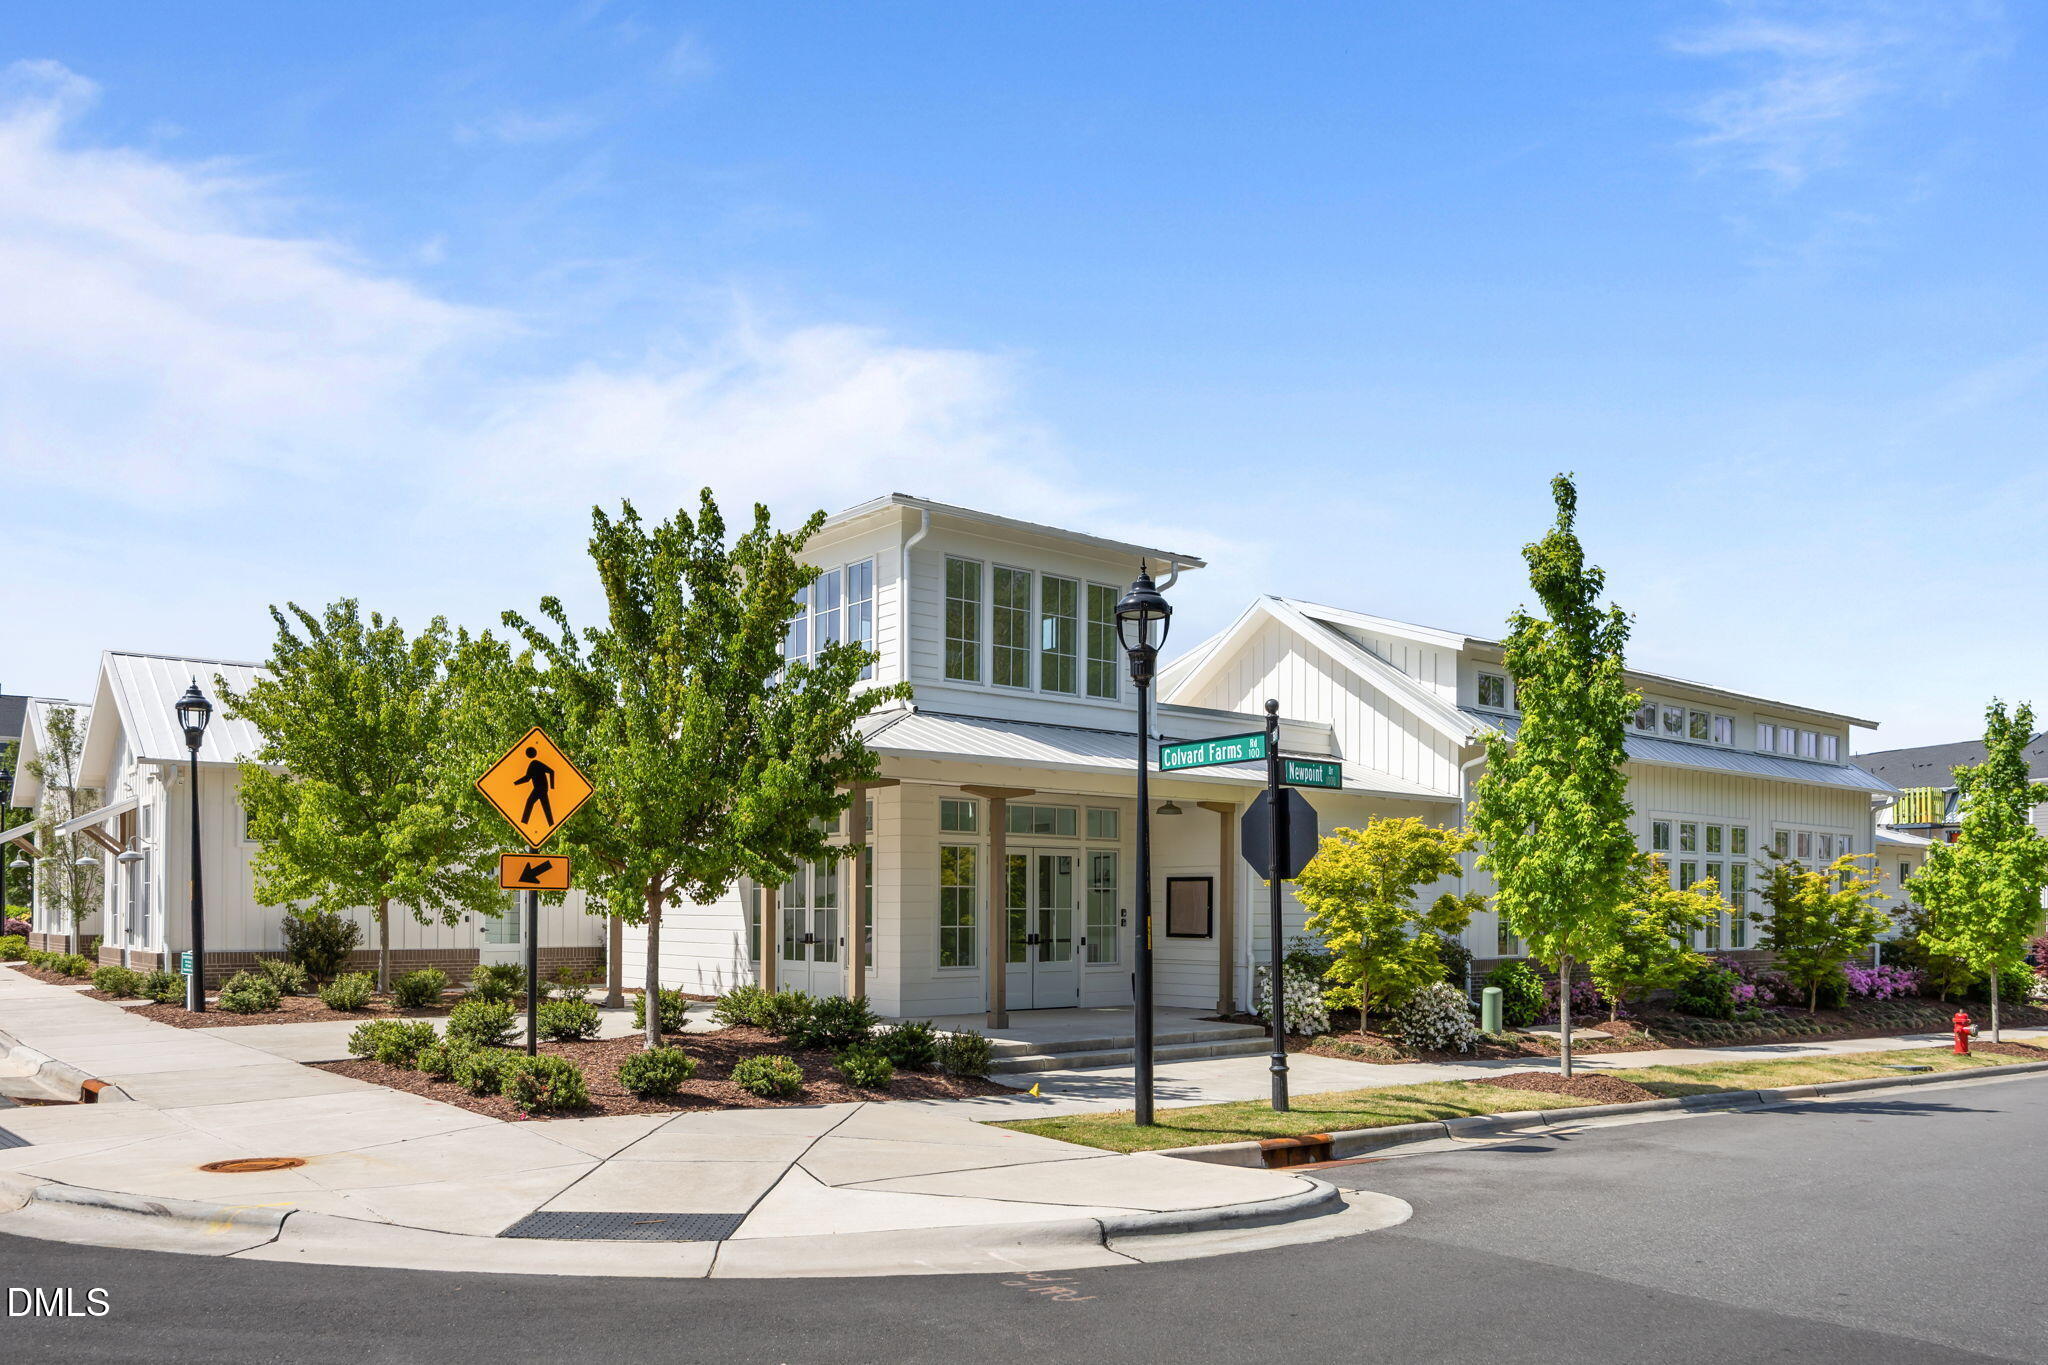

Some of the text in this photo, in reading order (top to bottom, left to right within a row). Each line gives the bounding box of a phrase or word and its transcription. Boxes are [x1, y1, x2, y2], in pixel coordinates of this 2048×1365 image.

[1164, 738, 1258, 766] Colvard Farms Rd
[1289, 762, 1323, 782] Newpoint
